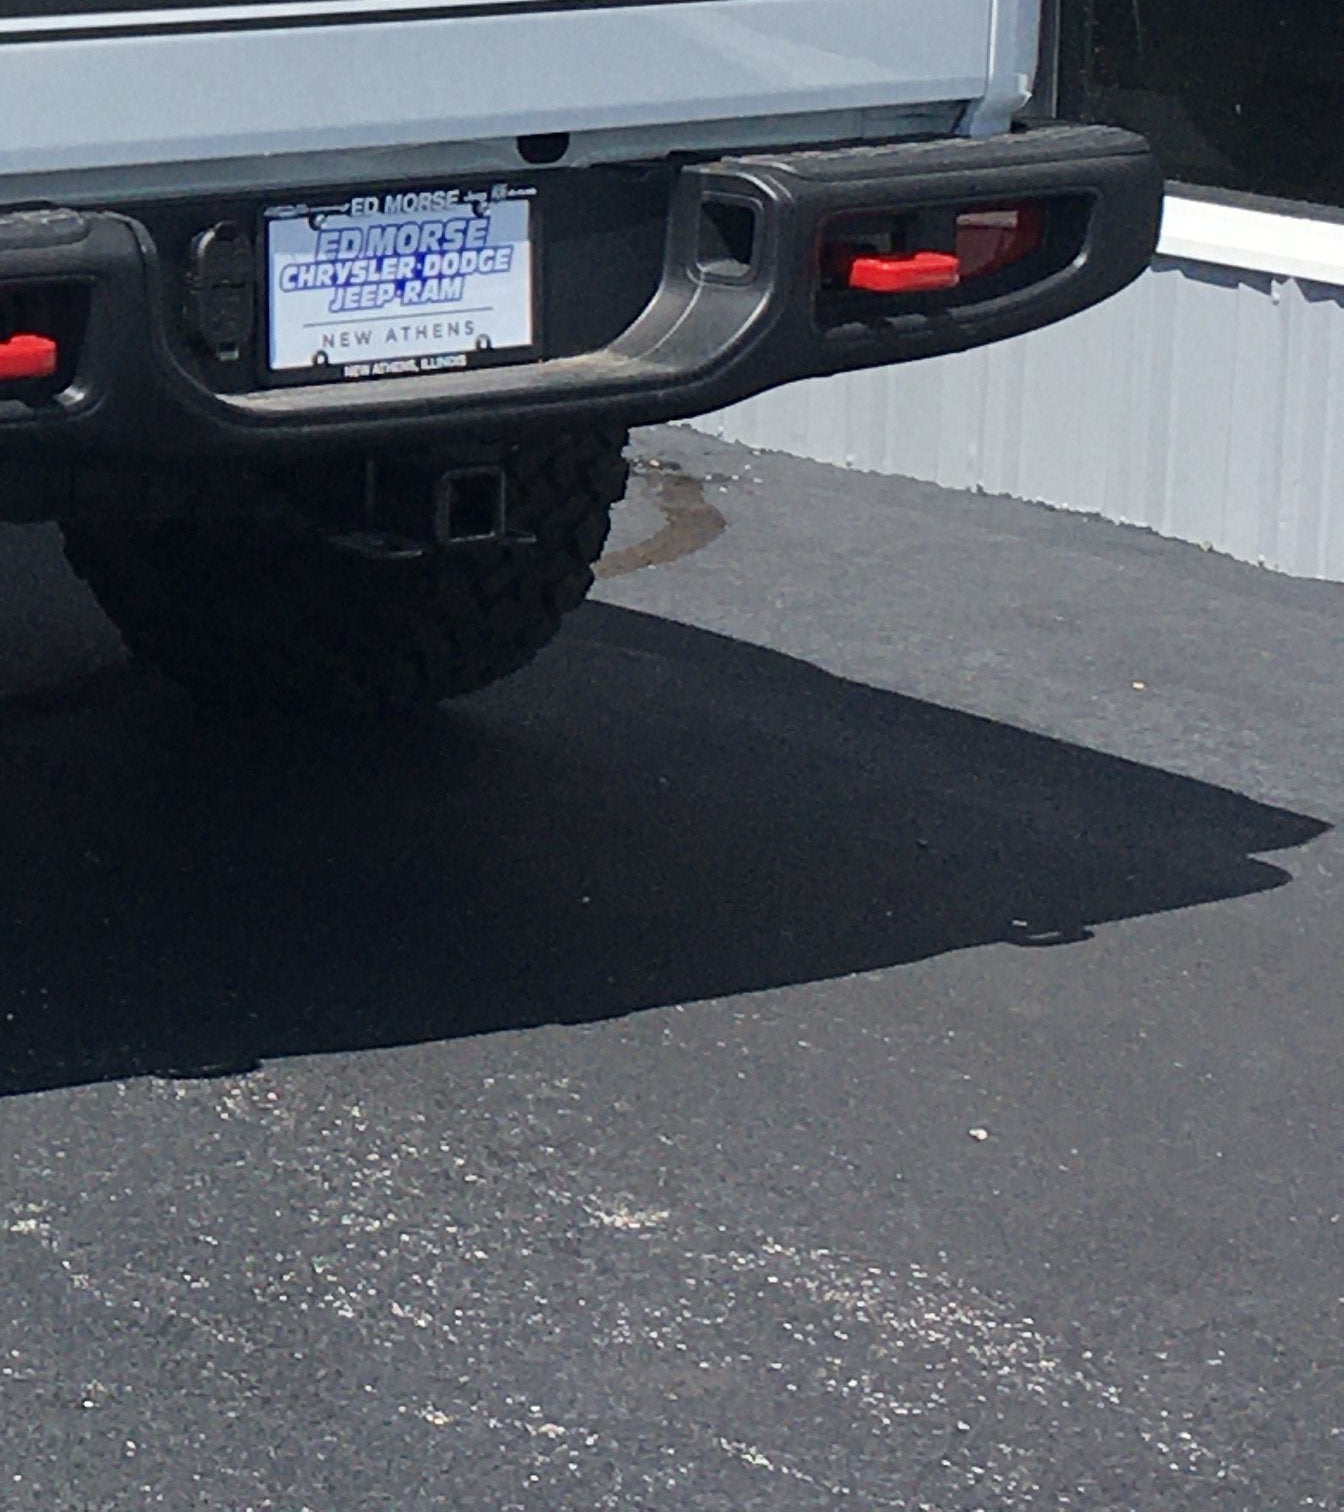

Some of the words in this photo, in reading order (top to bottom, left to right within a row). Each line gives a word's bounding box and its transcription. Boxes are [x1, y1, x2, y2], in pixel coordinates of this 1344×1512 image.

[350, 196, 379, 217] ED
[384, 190, 460, 215] MORSE
[315, 227, 362, 260] ED
[366, 217, 491, 258] MORSE
[322, 330, 373, 349] NEW
[385, 320, 475, 344] ATHENS
